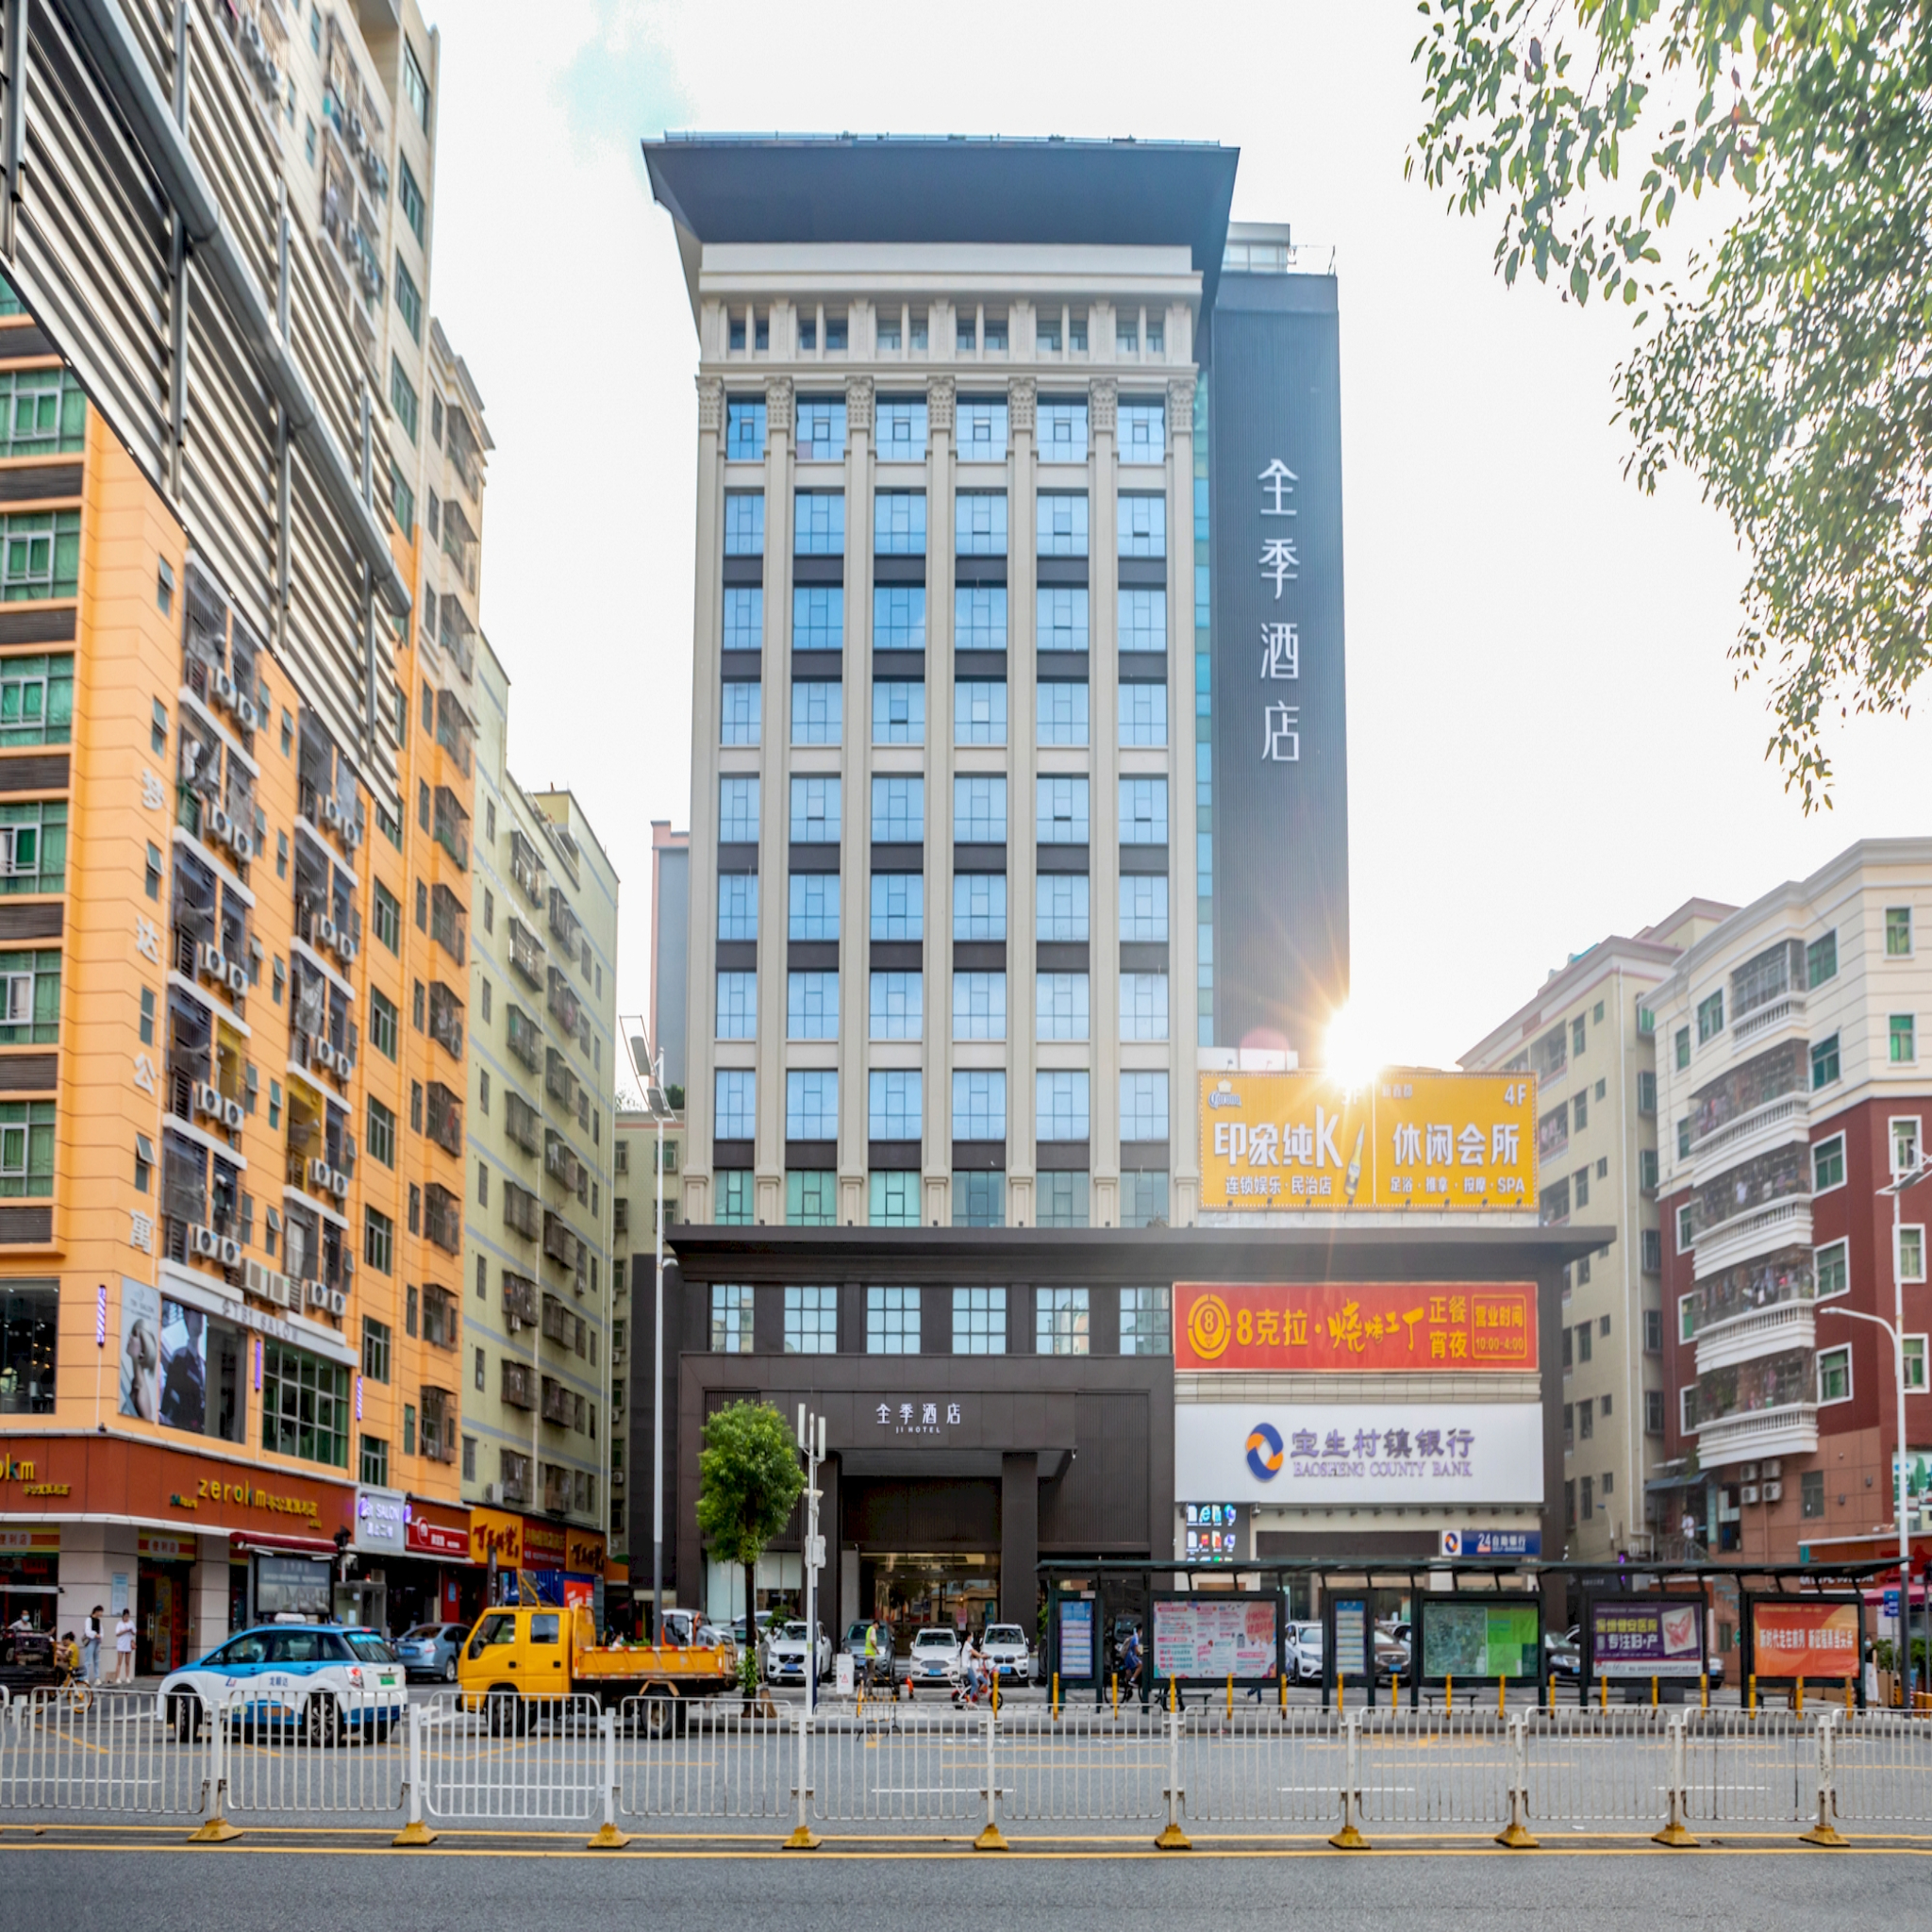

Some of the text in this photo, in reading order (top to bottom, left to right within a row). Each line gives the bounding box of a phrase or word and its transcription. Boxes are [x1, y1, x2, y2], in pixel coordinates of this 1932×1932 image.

[1257, 458, 1300, 761] 全季酒店
[1504, 1084, 1526, 1106] 4F
[1214, 1104, 1343, 1168] 印象纯K
[1392, 1123, 1520, 1166] 休闲会所
[1429, 1295, 1467, 1324] 正餐
[1475, 1306, 1524, 1327] 营业时间
[1429, 1330, 1467, 1359] 宵夜
[875, 1403, 960, 1424] 全季酒店
[895, 1425, 941, 1434] JI HOTEL
[1290, 1427, 1474, 1458] 宝生村镇银行
[1293, 1461, 1473, 1477] BAOSHENG COUNTY BANK
[198, 1478, 266, 1507] zerokm
[376, 1503, 400, 1522] SALON
